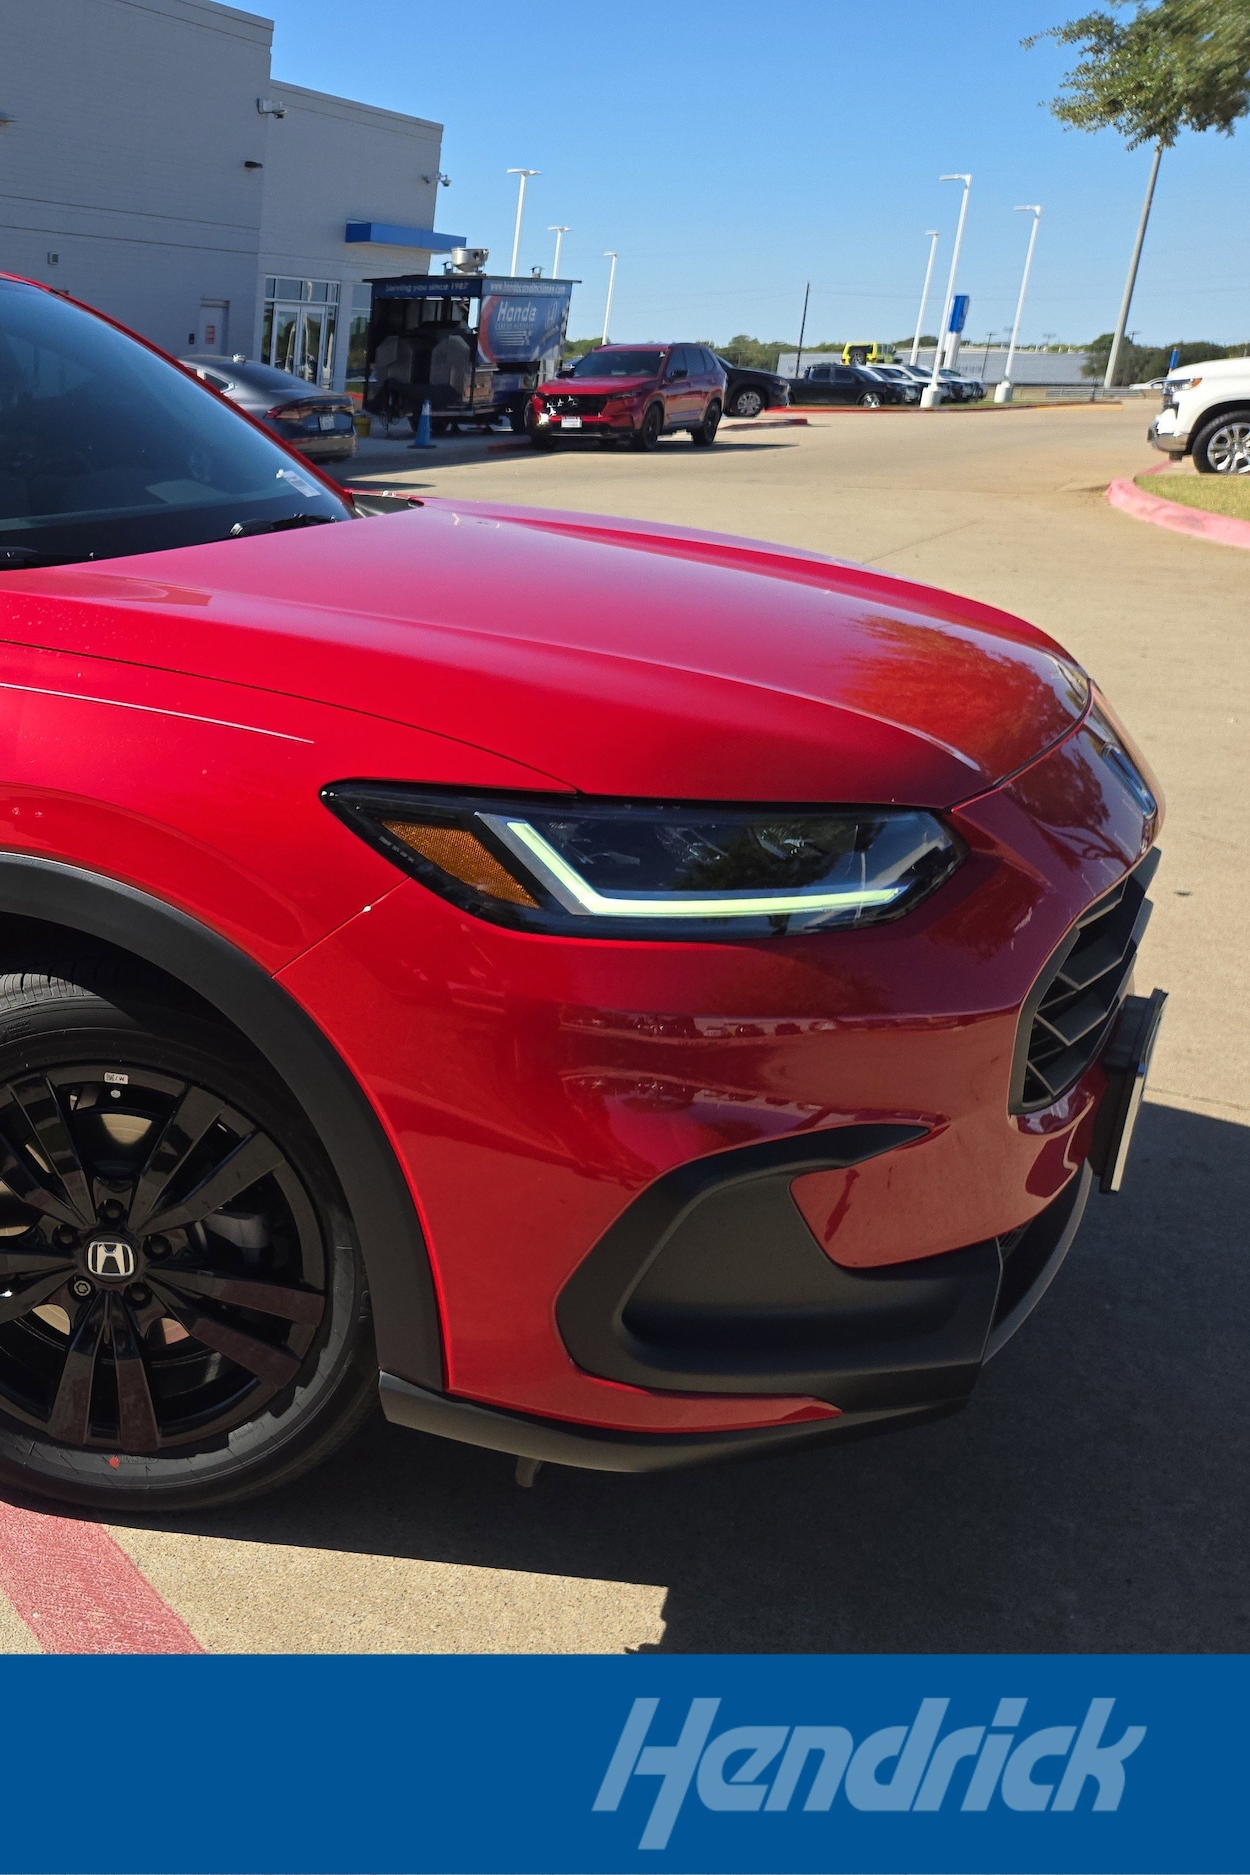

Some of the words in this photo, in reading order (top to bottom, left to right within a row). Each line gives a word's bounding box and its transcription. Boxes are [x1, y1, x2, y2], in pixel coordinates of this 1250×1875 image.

[385, 283, 411, 293] Serving
[413, 284, 427, 293] you
[429, 283, 448, 291] since
[451, 281, 469, 291] 1987
[497, 301, 536, 322] Honda
